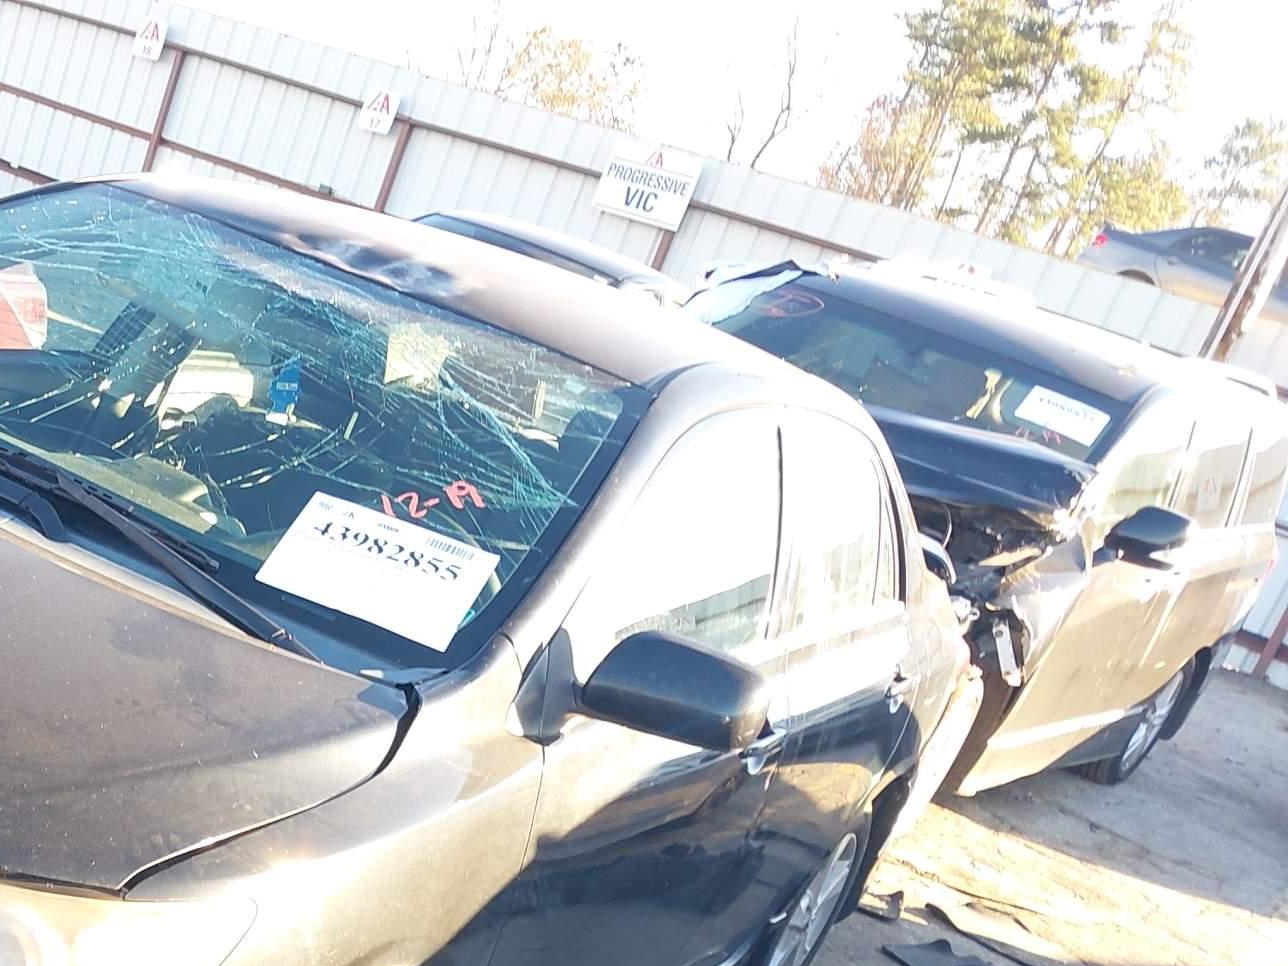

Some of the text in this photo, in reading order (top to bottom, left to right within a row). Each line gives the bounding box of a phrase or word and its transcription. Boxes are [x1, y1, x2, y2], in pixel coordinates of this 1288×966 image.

[607, 162, 690, 196] PROGRESSIVE
[624, 186, 659, 213] VIC
[313, 521, 462, 580] 43982855
